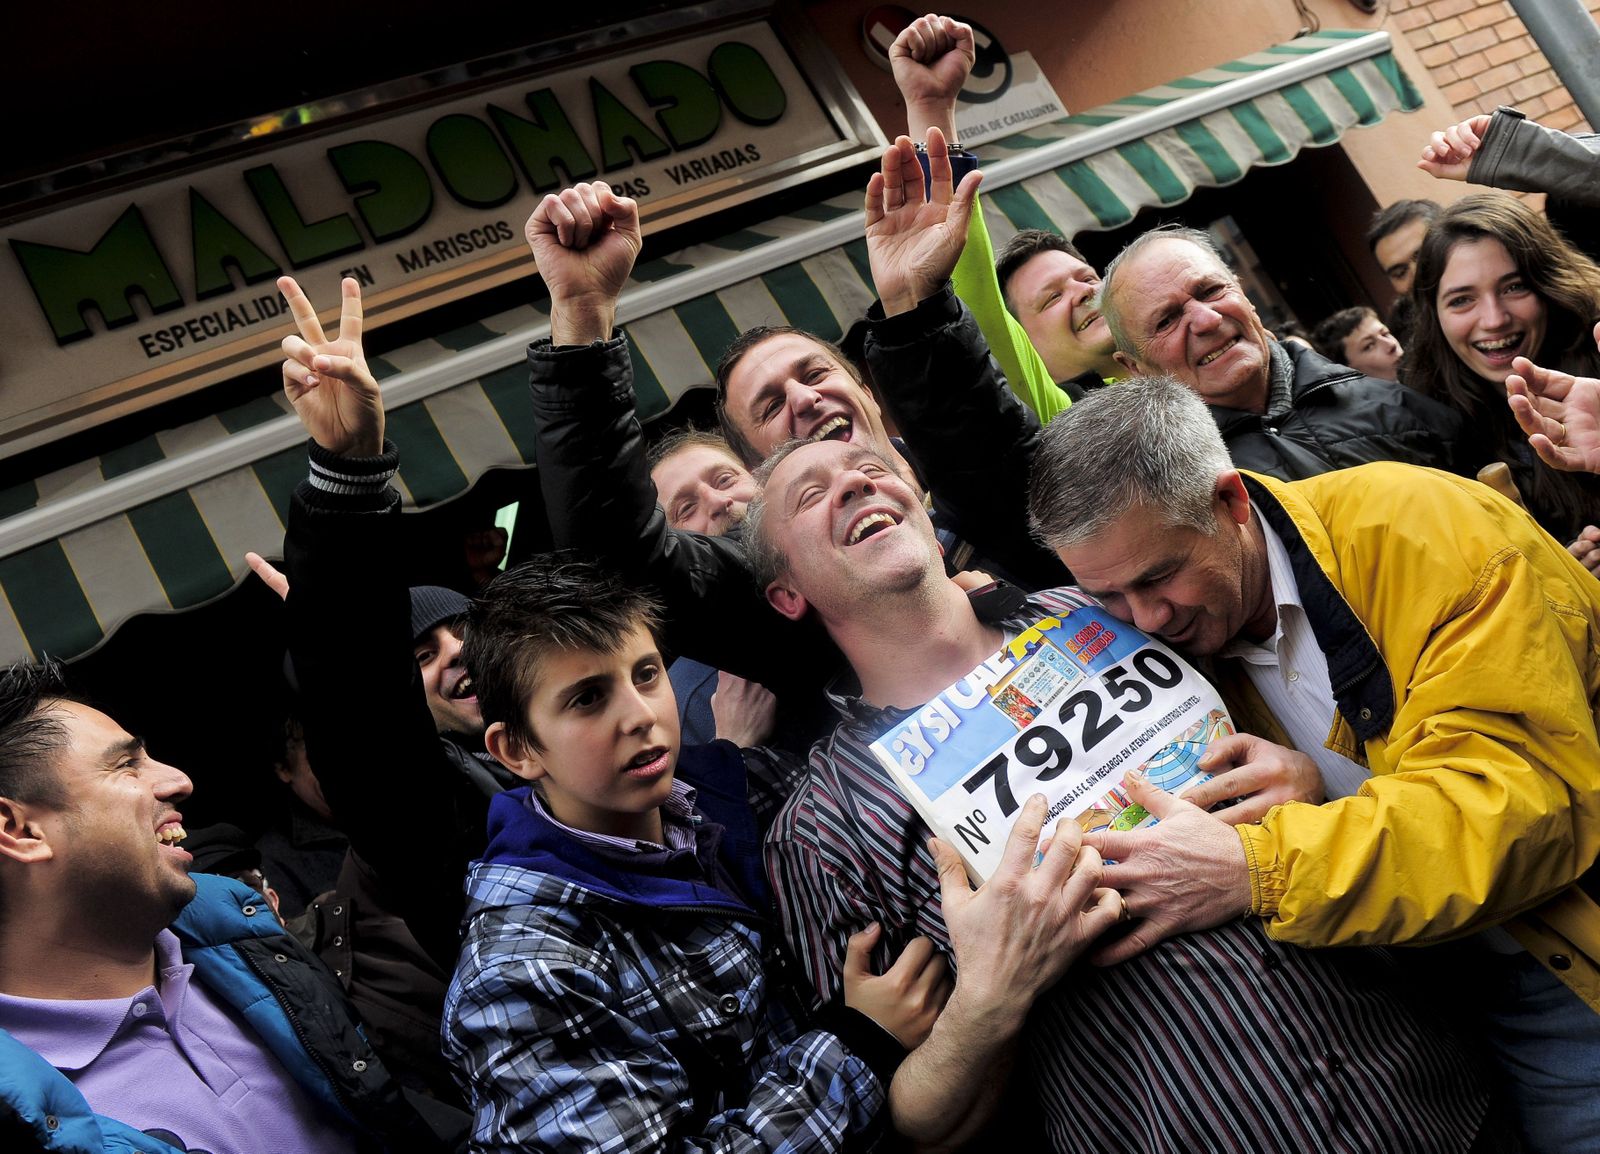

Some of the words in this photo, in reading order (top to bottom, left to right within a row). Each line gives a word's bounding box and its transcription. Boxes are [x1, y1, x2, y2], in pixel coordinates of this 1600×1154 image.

[958, 123, 988, 141] TERIA
[988, 118, 1003, 131] DE
[1004, 102, 1059, 125] CATALUNYA
[8, 41, 787, 346] MALDONADO
[138, 289, 303, 359] ESPECIALIDA
[396, 220, 514, 274] MARISCOS
[611, 177, 650, 199] PAS
[664, 143, 761, 187] VARIADAS
[1065, 637, 1081, 654] EL
[1075, 620, 1104, 645] GORDO
[1077, 649, 1093, 665] DE
[1087, 630, 1116, 656] NAVIDAD
[962, 648, 1183, 818] 79250
[1042, 793, 1075, 828] CIPACIONES
[1088, 774, 1099, 787] SIN
[1096, 754, 1124, 779] RECARGO
[1122, 749, 1132, 760] EN
[1131, 728, 1155, 754] ATENCIÓN
[1158, 708, 1181, 730] NUESTROS
